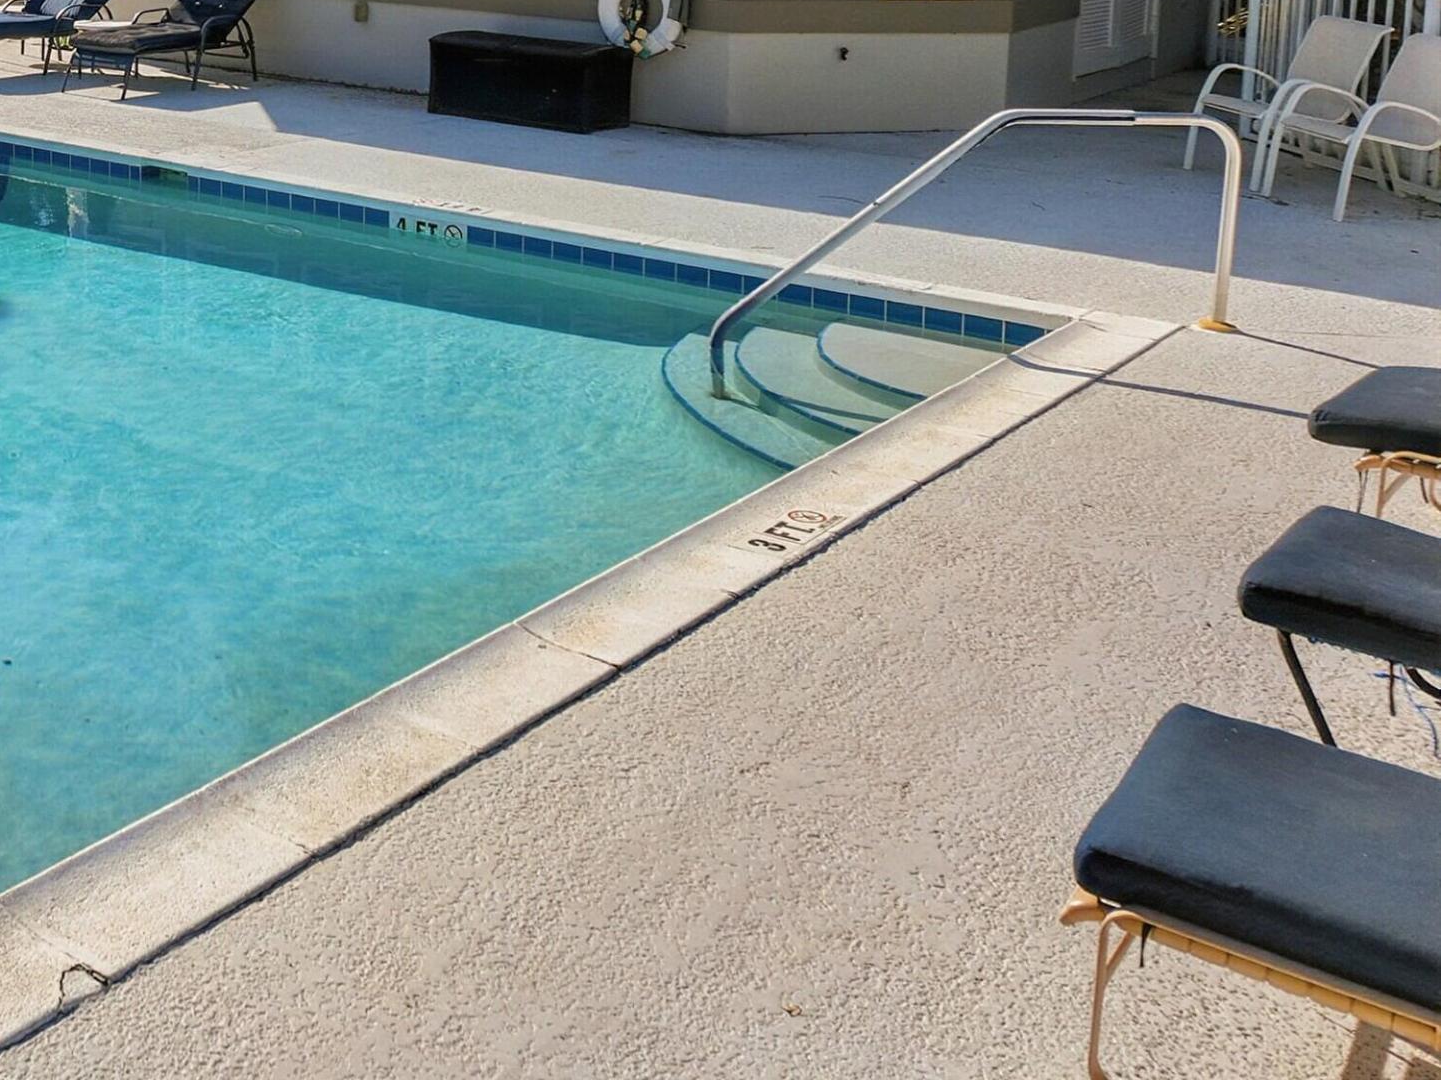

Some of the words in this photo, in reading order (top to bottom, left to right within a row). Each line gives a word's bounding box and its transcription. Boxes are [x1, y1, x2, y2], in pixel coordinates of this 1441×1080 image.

[416, 221, 437, 235] FT
[764, 521, 816, 542] FT
[748, 539, 787, 552] 3
